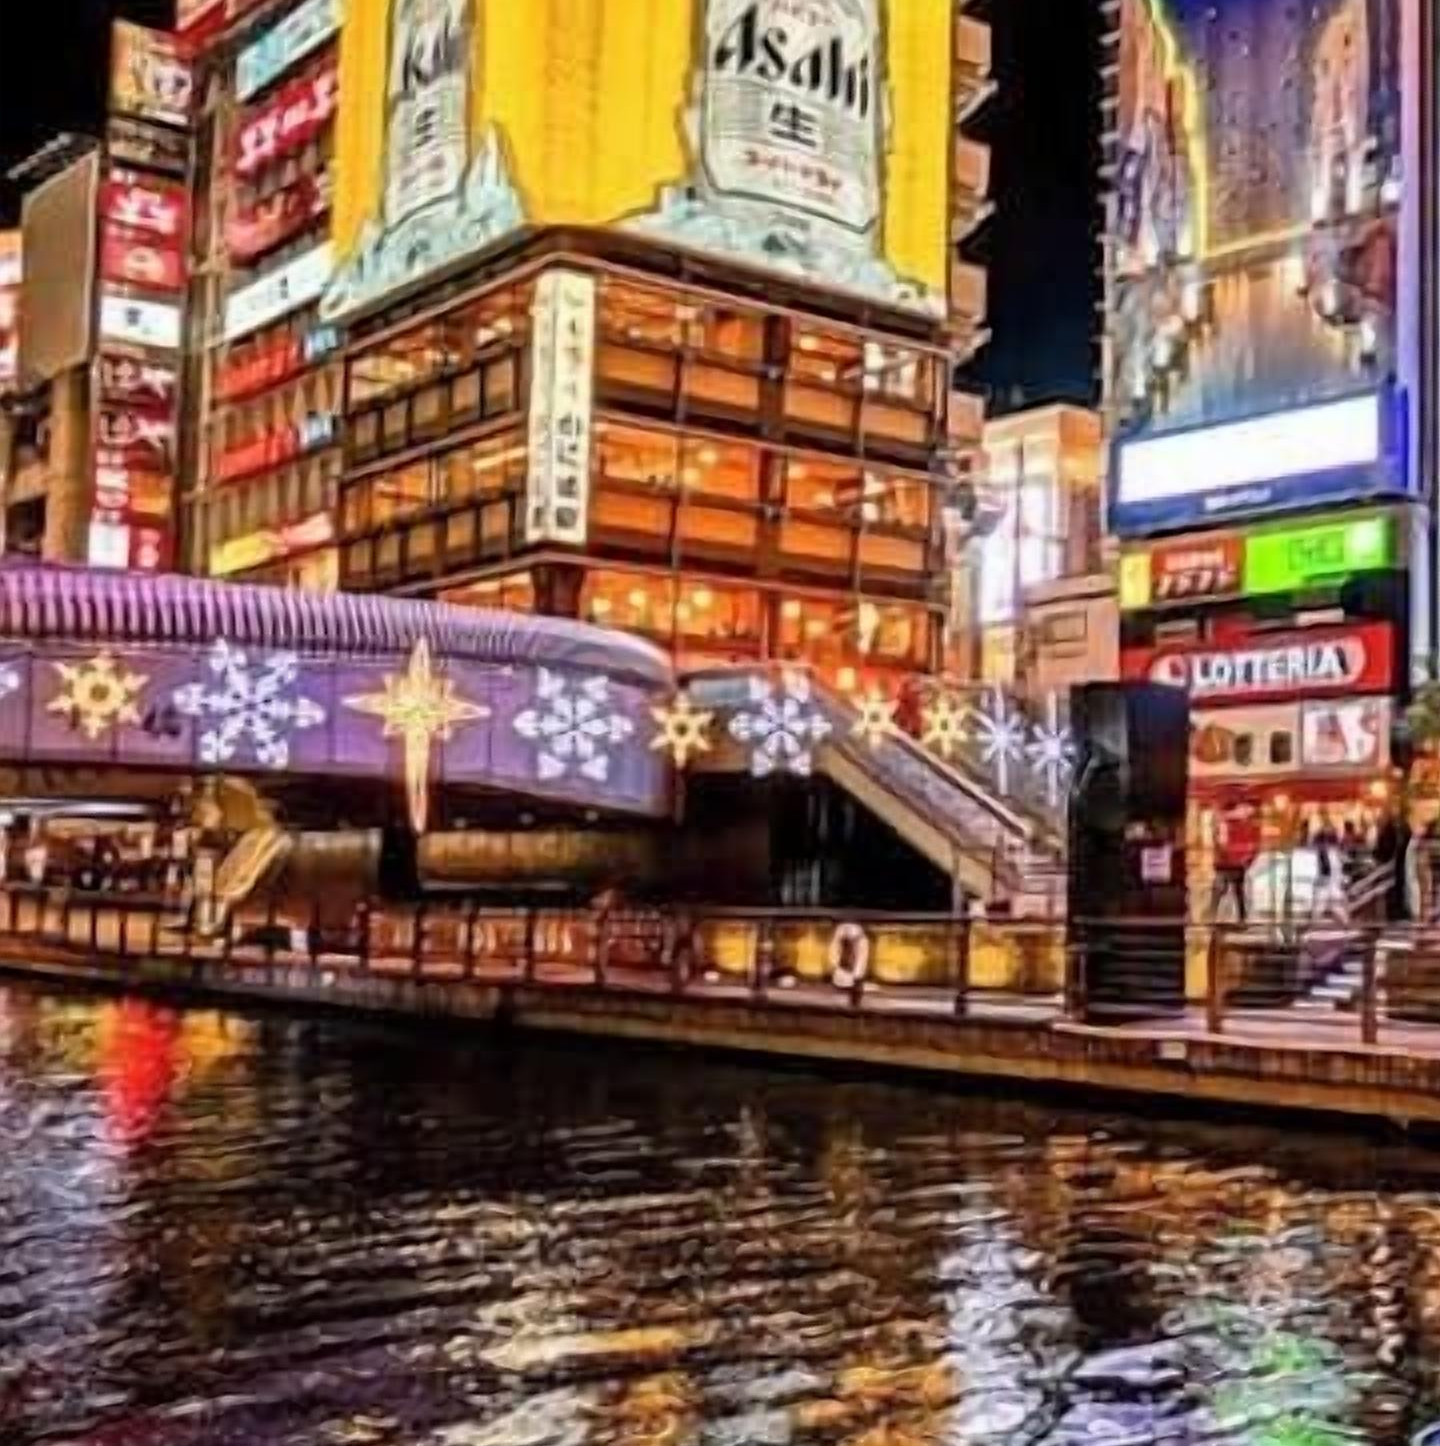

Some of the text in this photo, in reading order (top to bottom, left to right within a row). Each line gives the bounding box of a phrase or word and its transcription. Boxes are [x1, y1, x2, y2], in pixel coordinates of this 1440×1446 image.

[713, 3, 870, 120] Asahi
[769, 101, 818, 149] 生
[1192, 643, 1350, 691] LOTTERIA
